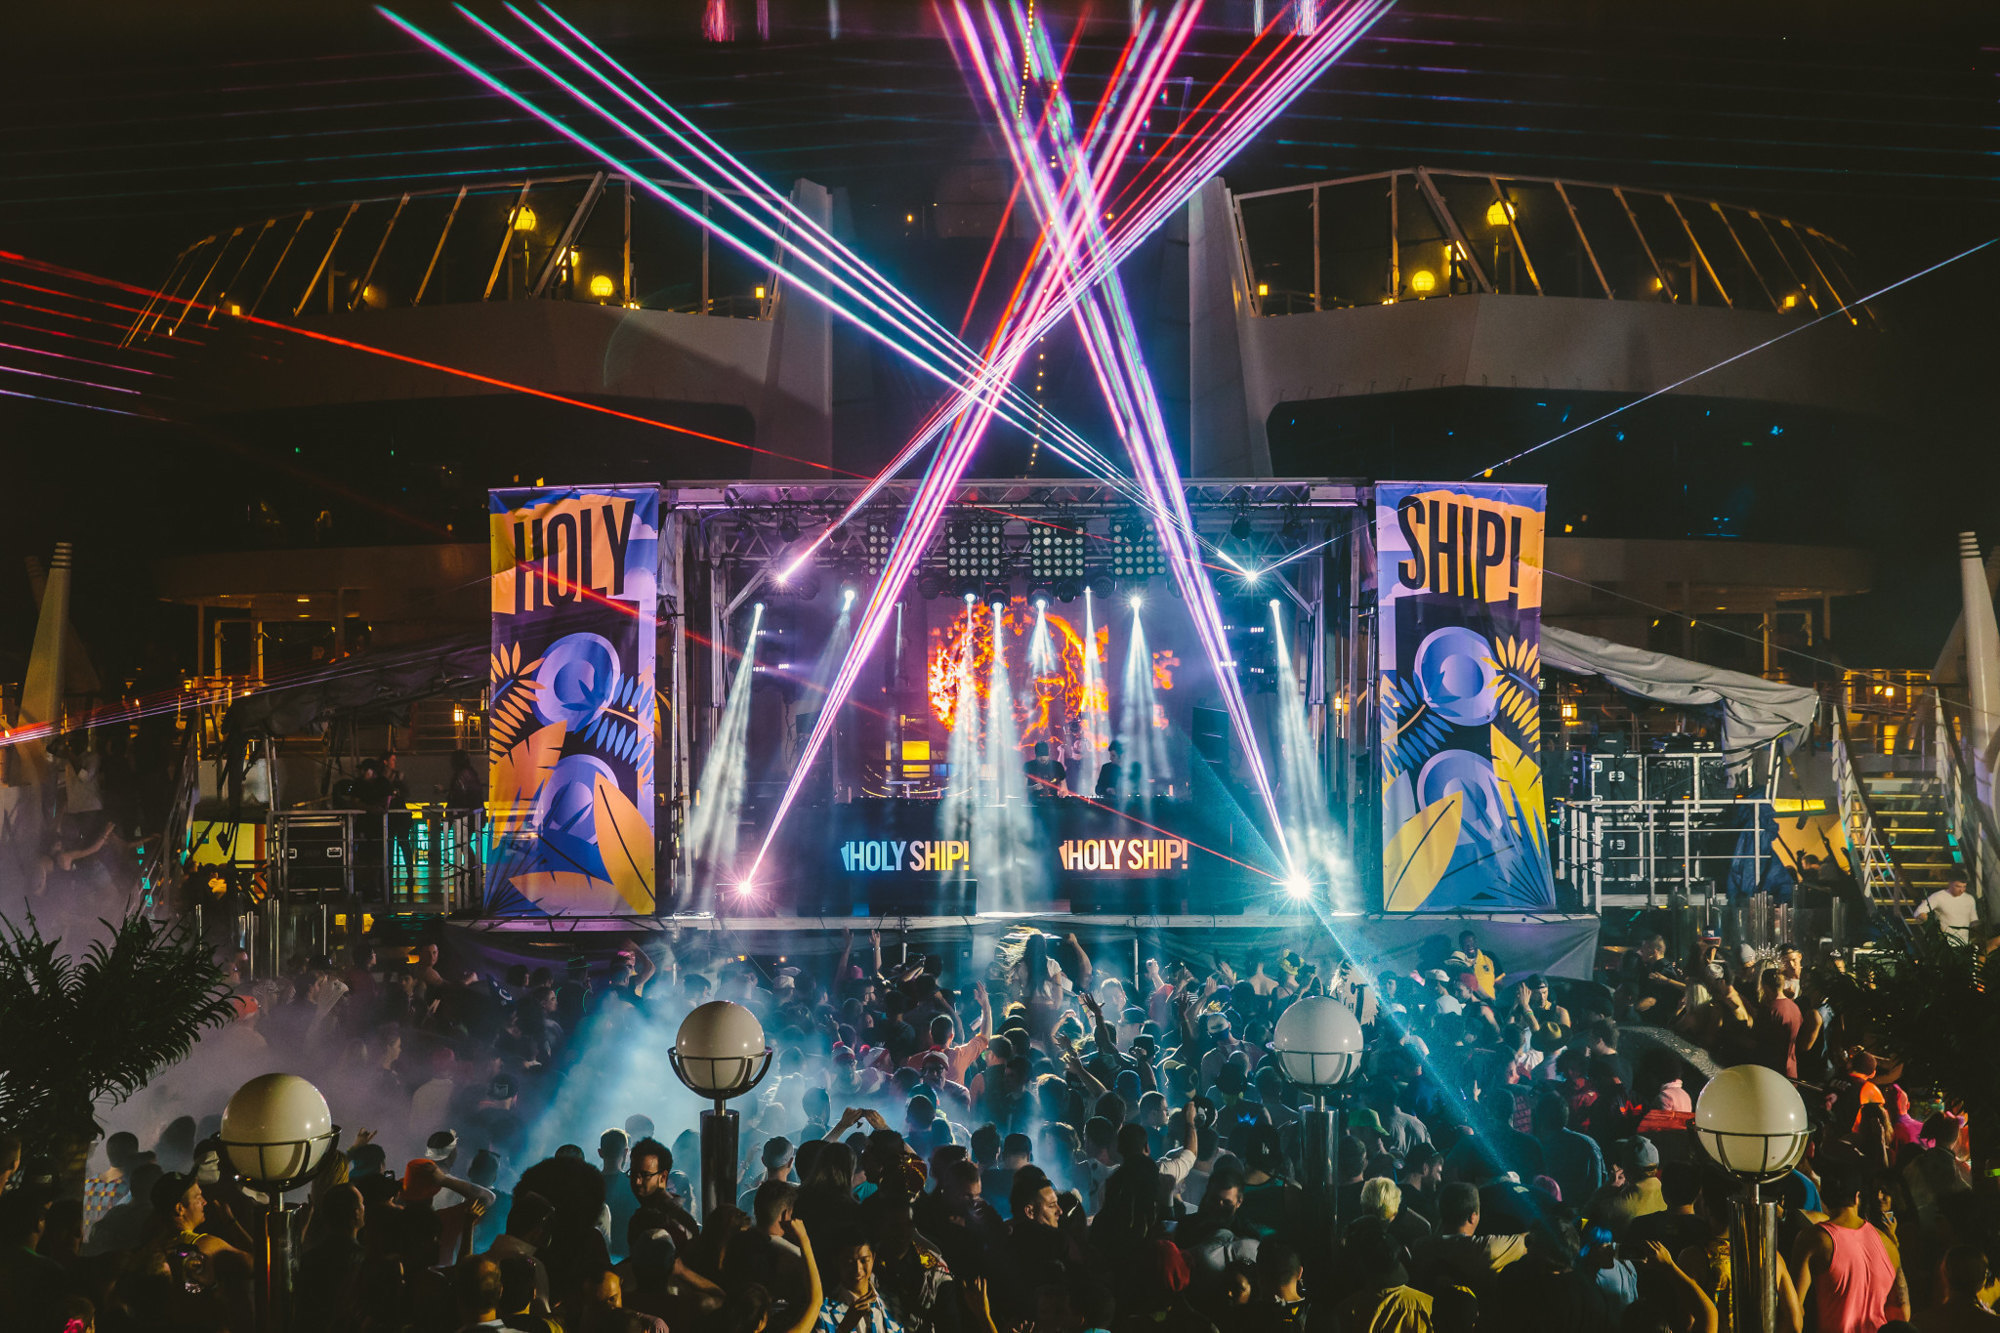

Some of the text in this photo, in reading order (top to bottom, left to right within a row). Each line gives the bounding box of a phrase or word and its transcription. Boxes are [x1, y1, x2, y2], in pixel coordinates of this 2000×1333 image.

[514, 500, 636, 613] HOLY
[1398, 495, 1522, 609] SHIP!
[849, 840, 970, 871] HOLY SHIP!
[1068, 839, 1189, 871] HOLY SHIP!
